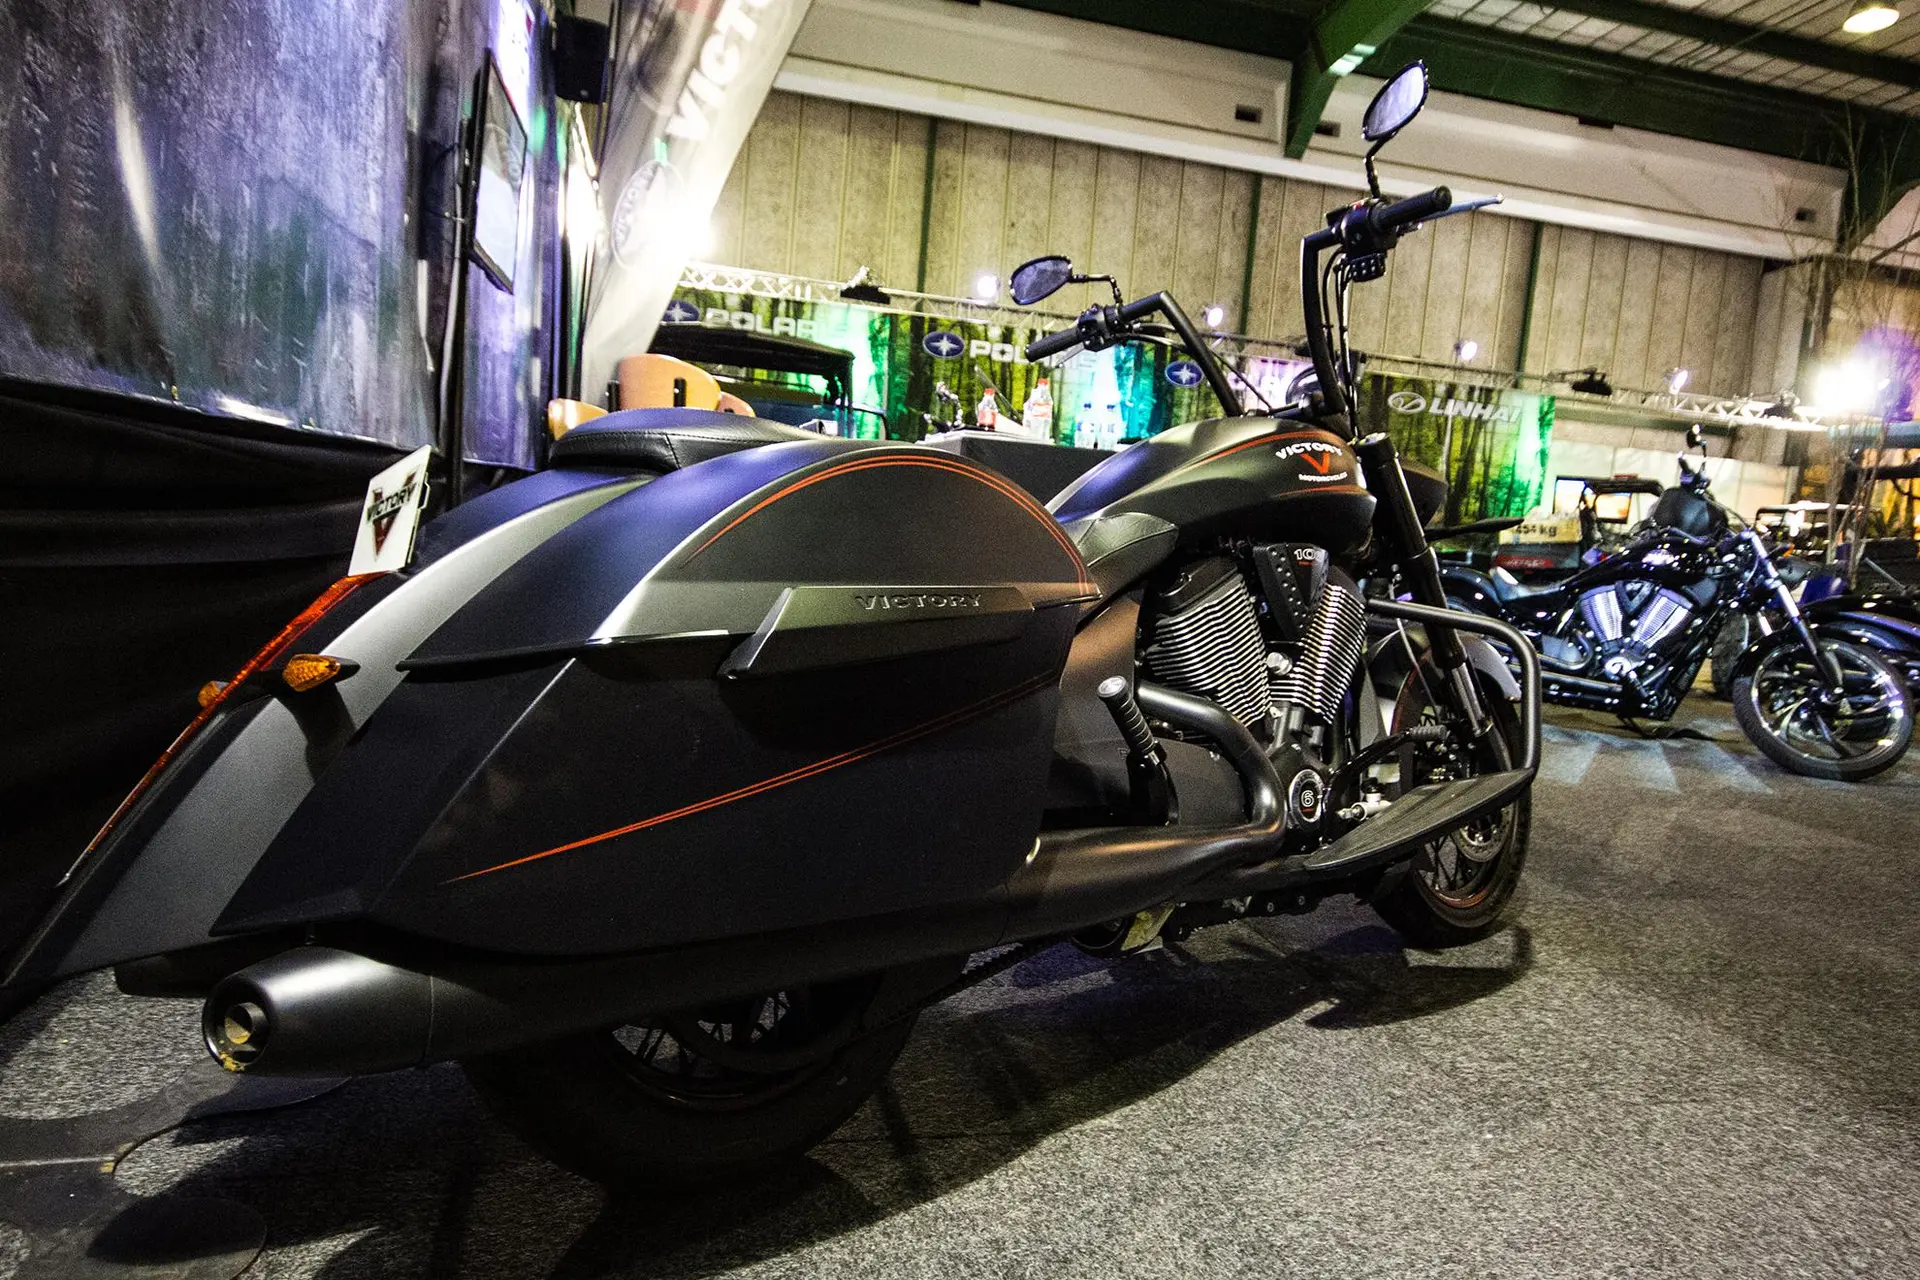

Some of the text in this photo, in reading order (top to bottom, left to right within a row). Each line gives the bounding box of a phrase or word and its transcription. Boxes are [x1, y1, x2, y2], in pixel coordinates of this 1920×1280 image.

[665, 0, 773, 141] VICT
[1429, 397, 1522, 423] LINHAI
[1276, 442, 1343, 460] VICTORY
[1298, 471, 1348, 482] MOTORCYCLES
[366, 482, 417, 521] VICTORY
[1540, 524, 1557, 538] kg
[855, 594, 982, 610] VICTORY
[1301, 789, 1316, 808] 6
